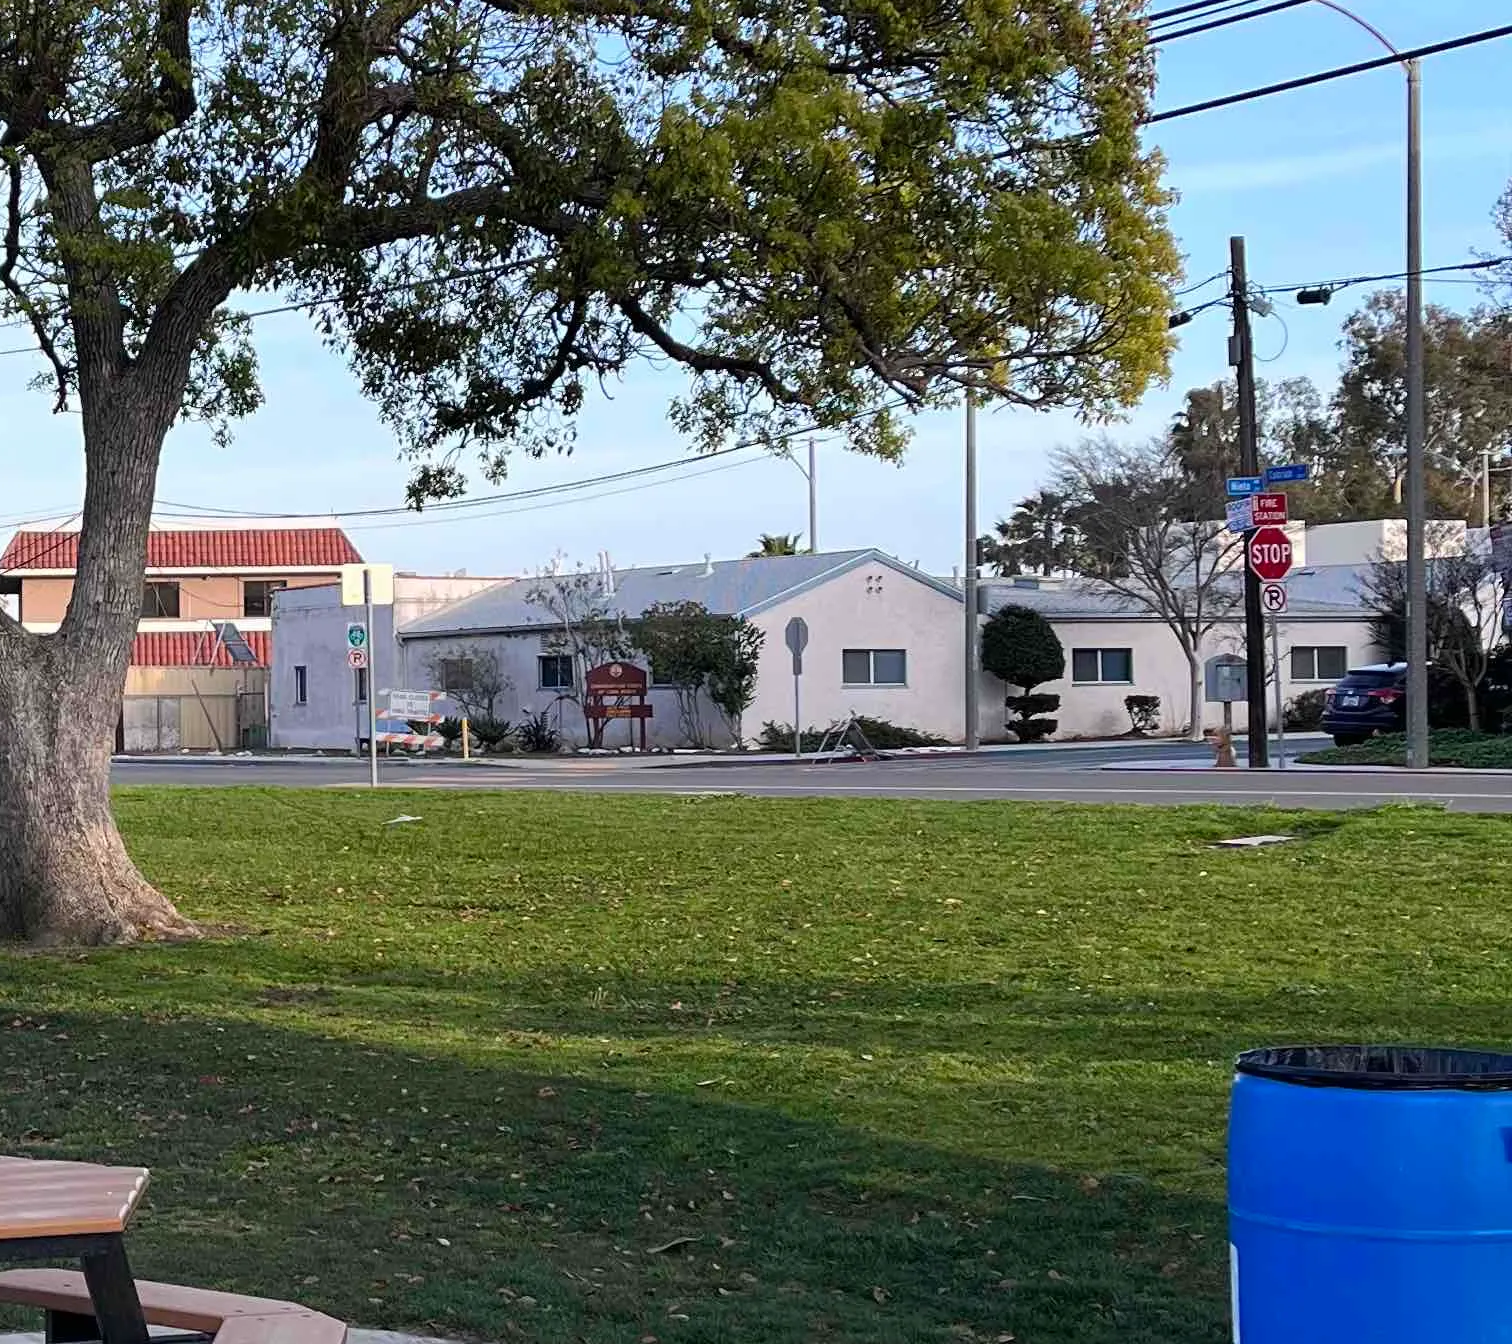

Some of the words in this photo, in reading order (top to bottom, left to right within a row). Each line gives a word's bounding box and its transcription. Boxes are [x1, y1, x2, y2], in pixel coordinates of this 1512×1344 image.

[1259, 498, 1278, 508] FIRE
[1253, 511, 1286, 521] STATION
[1252, 543, 1291, 565] STOP
